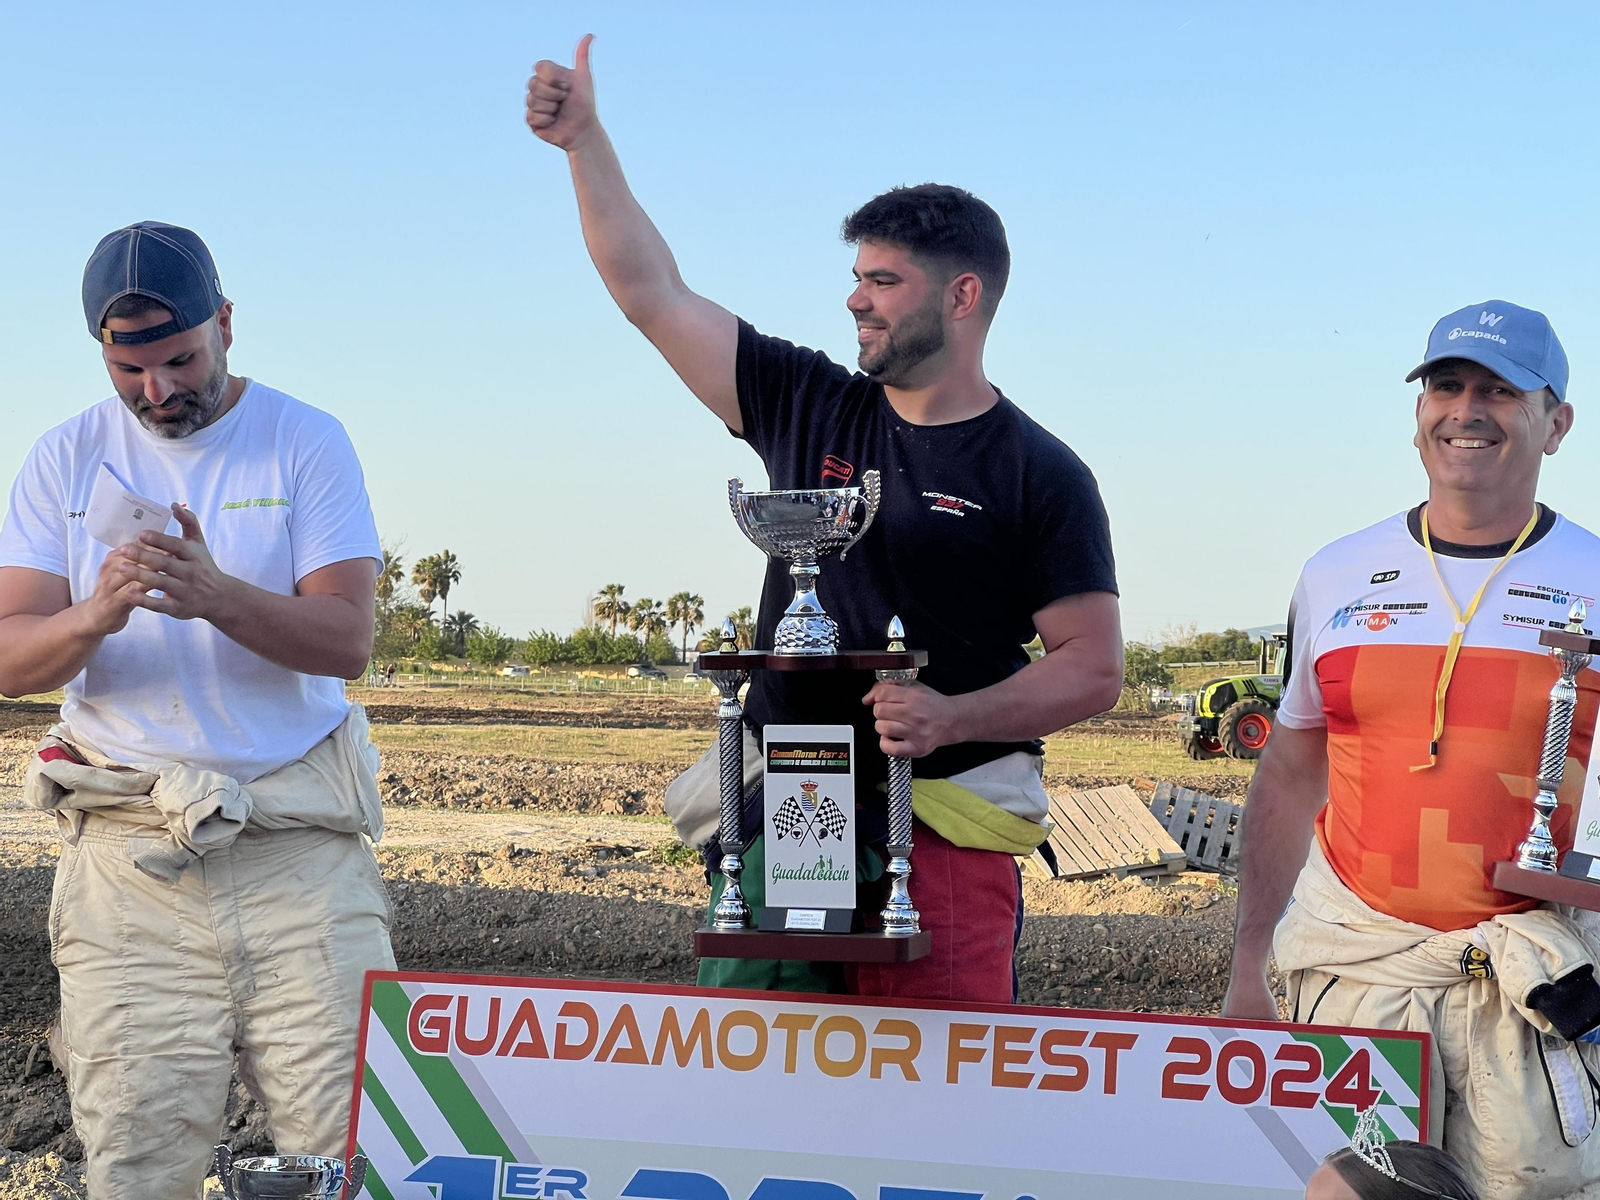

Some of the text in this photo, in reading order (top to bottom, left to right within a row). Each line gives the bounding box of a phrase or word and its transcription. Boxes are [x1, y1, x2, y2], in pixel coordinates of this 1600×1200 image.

[1479, 311, 1504, 327] W
[823, 459, 850, 475] DUCATI
[922, 491, 983, 510] MONSTER
[1537, 585, 1571, 597] ESCUELA
[1344, 604, 1380, 613] SYMISUR
[1356, 618, 1399, 626] VIMAN
[1502, 614, 1545, 626] SYMISUR
[408, 993, 1384, 1112] GUADAMOTOR FEST 2024
